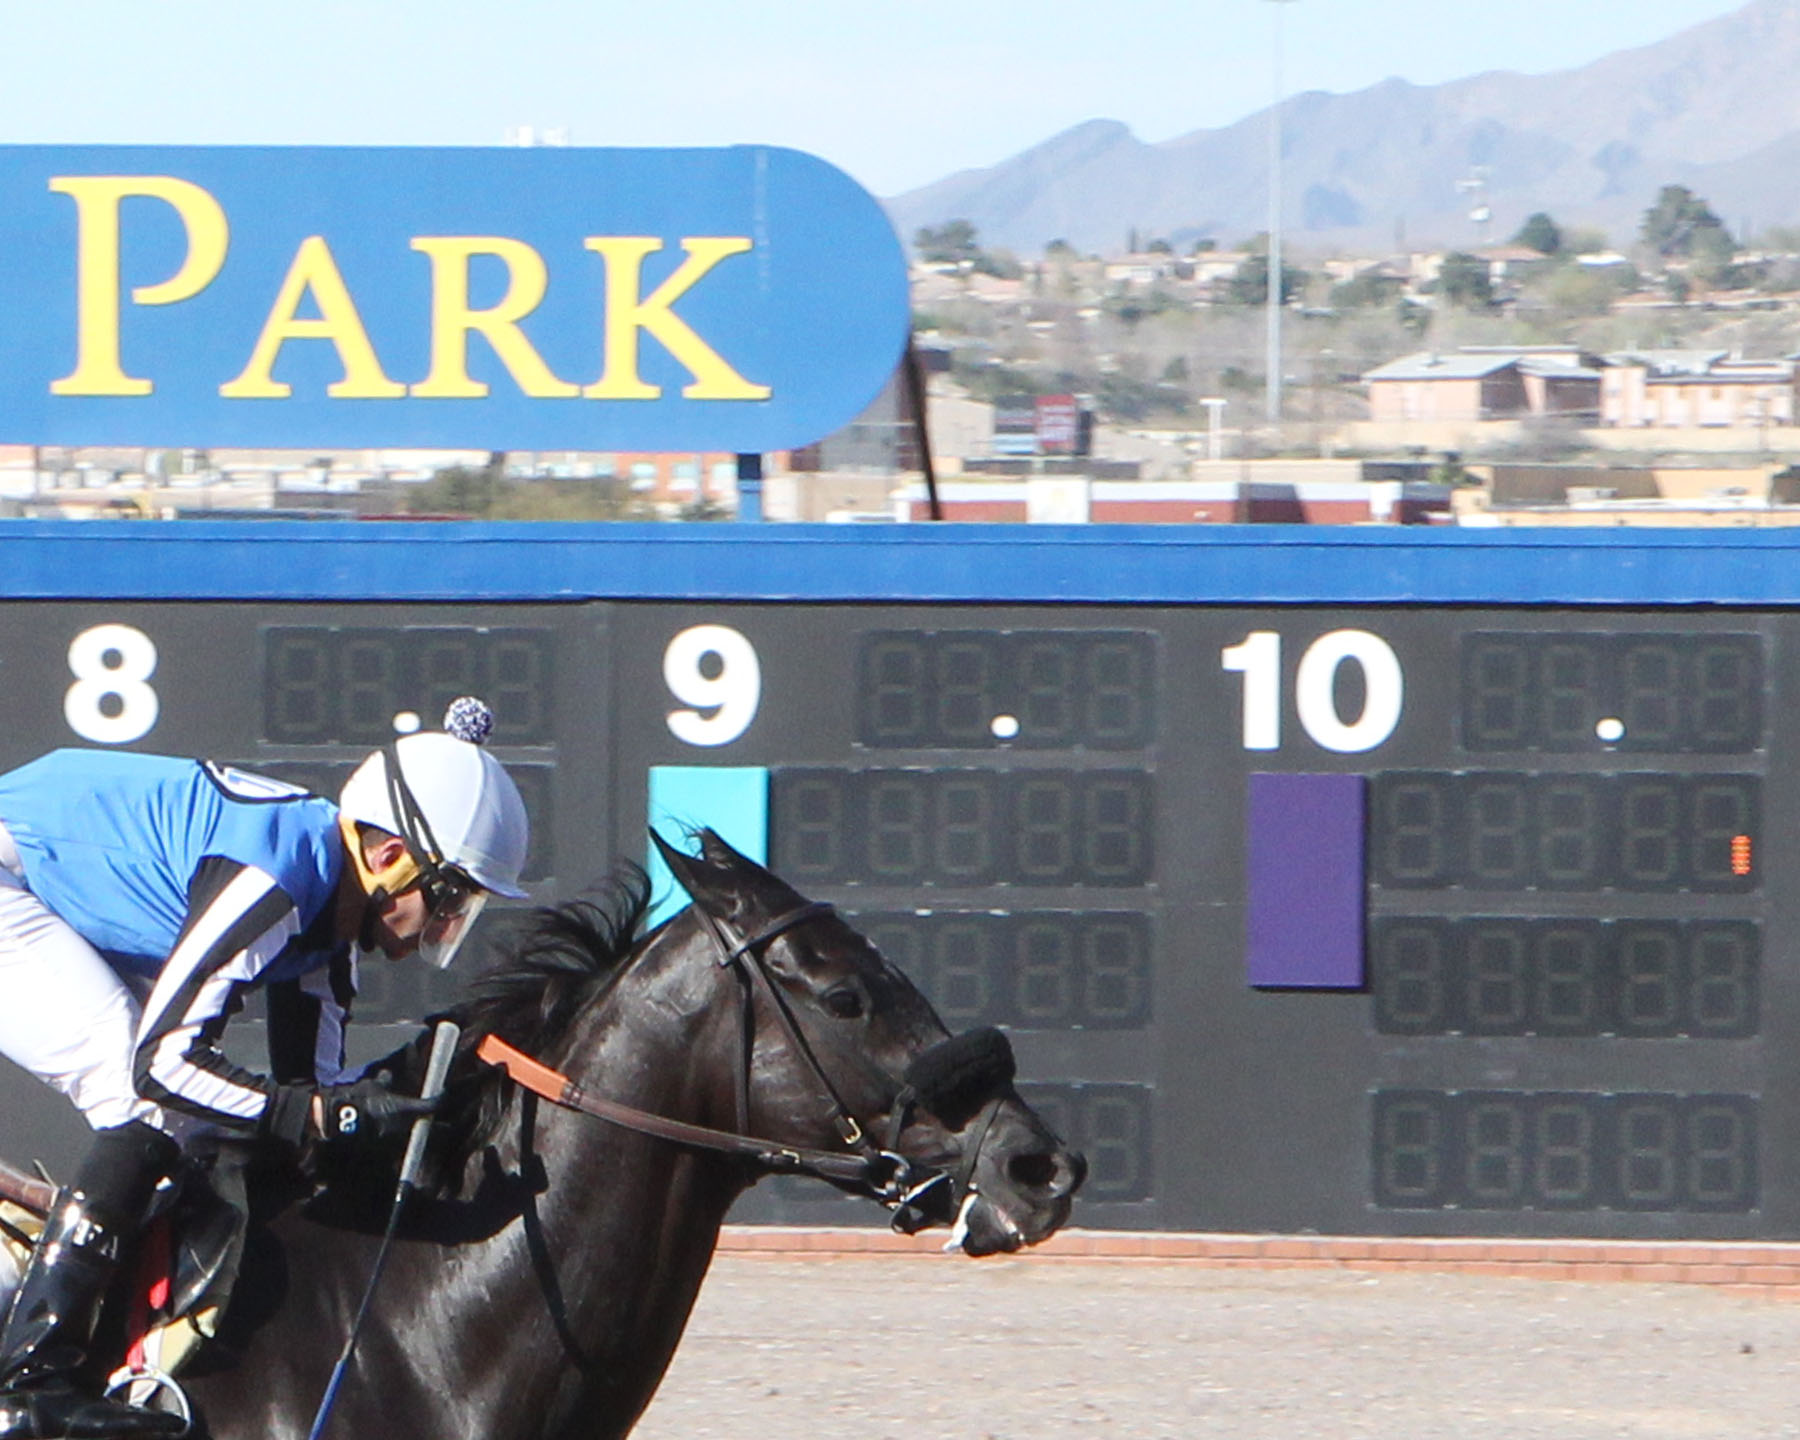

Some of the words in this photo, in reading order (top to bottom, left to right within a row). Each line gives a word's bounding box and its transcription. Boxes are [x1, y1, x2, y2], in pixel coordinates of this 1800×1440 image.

[49, 175, 772, 400] PARK
[64, 624, 159, 743] 8
[663, 625, 761, 746] 9
[1222, 630, 1403, 752] 10
